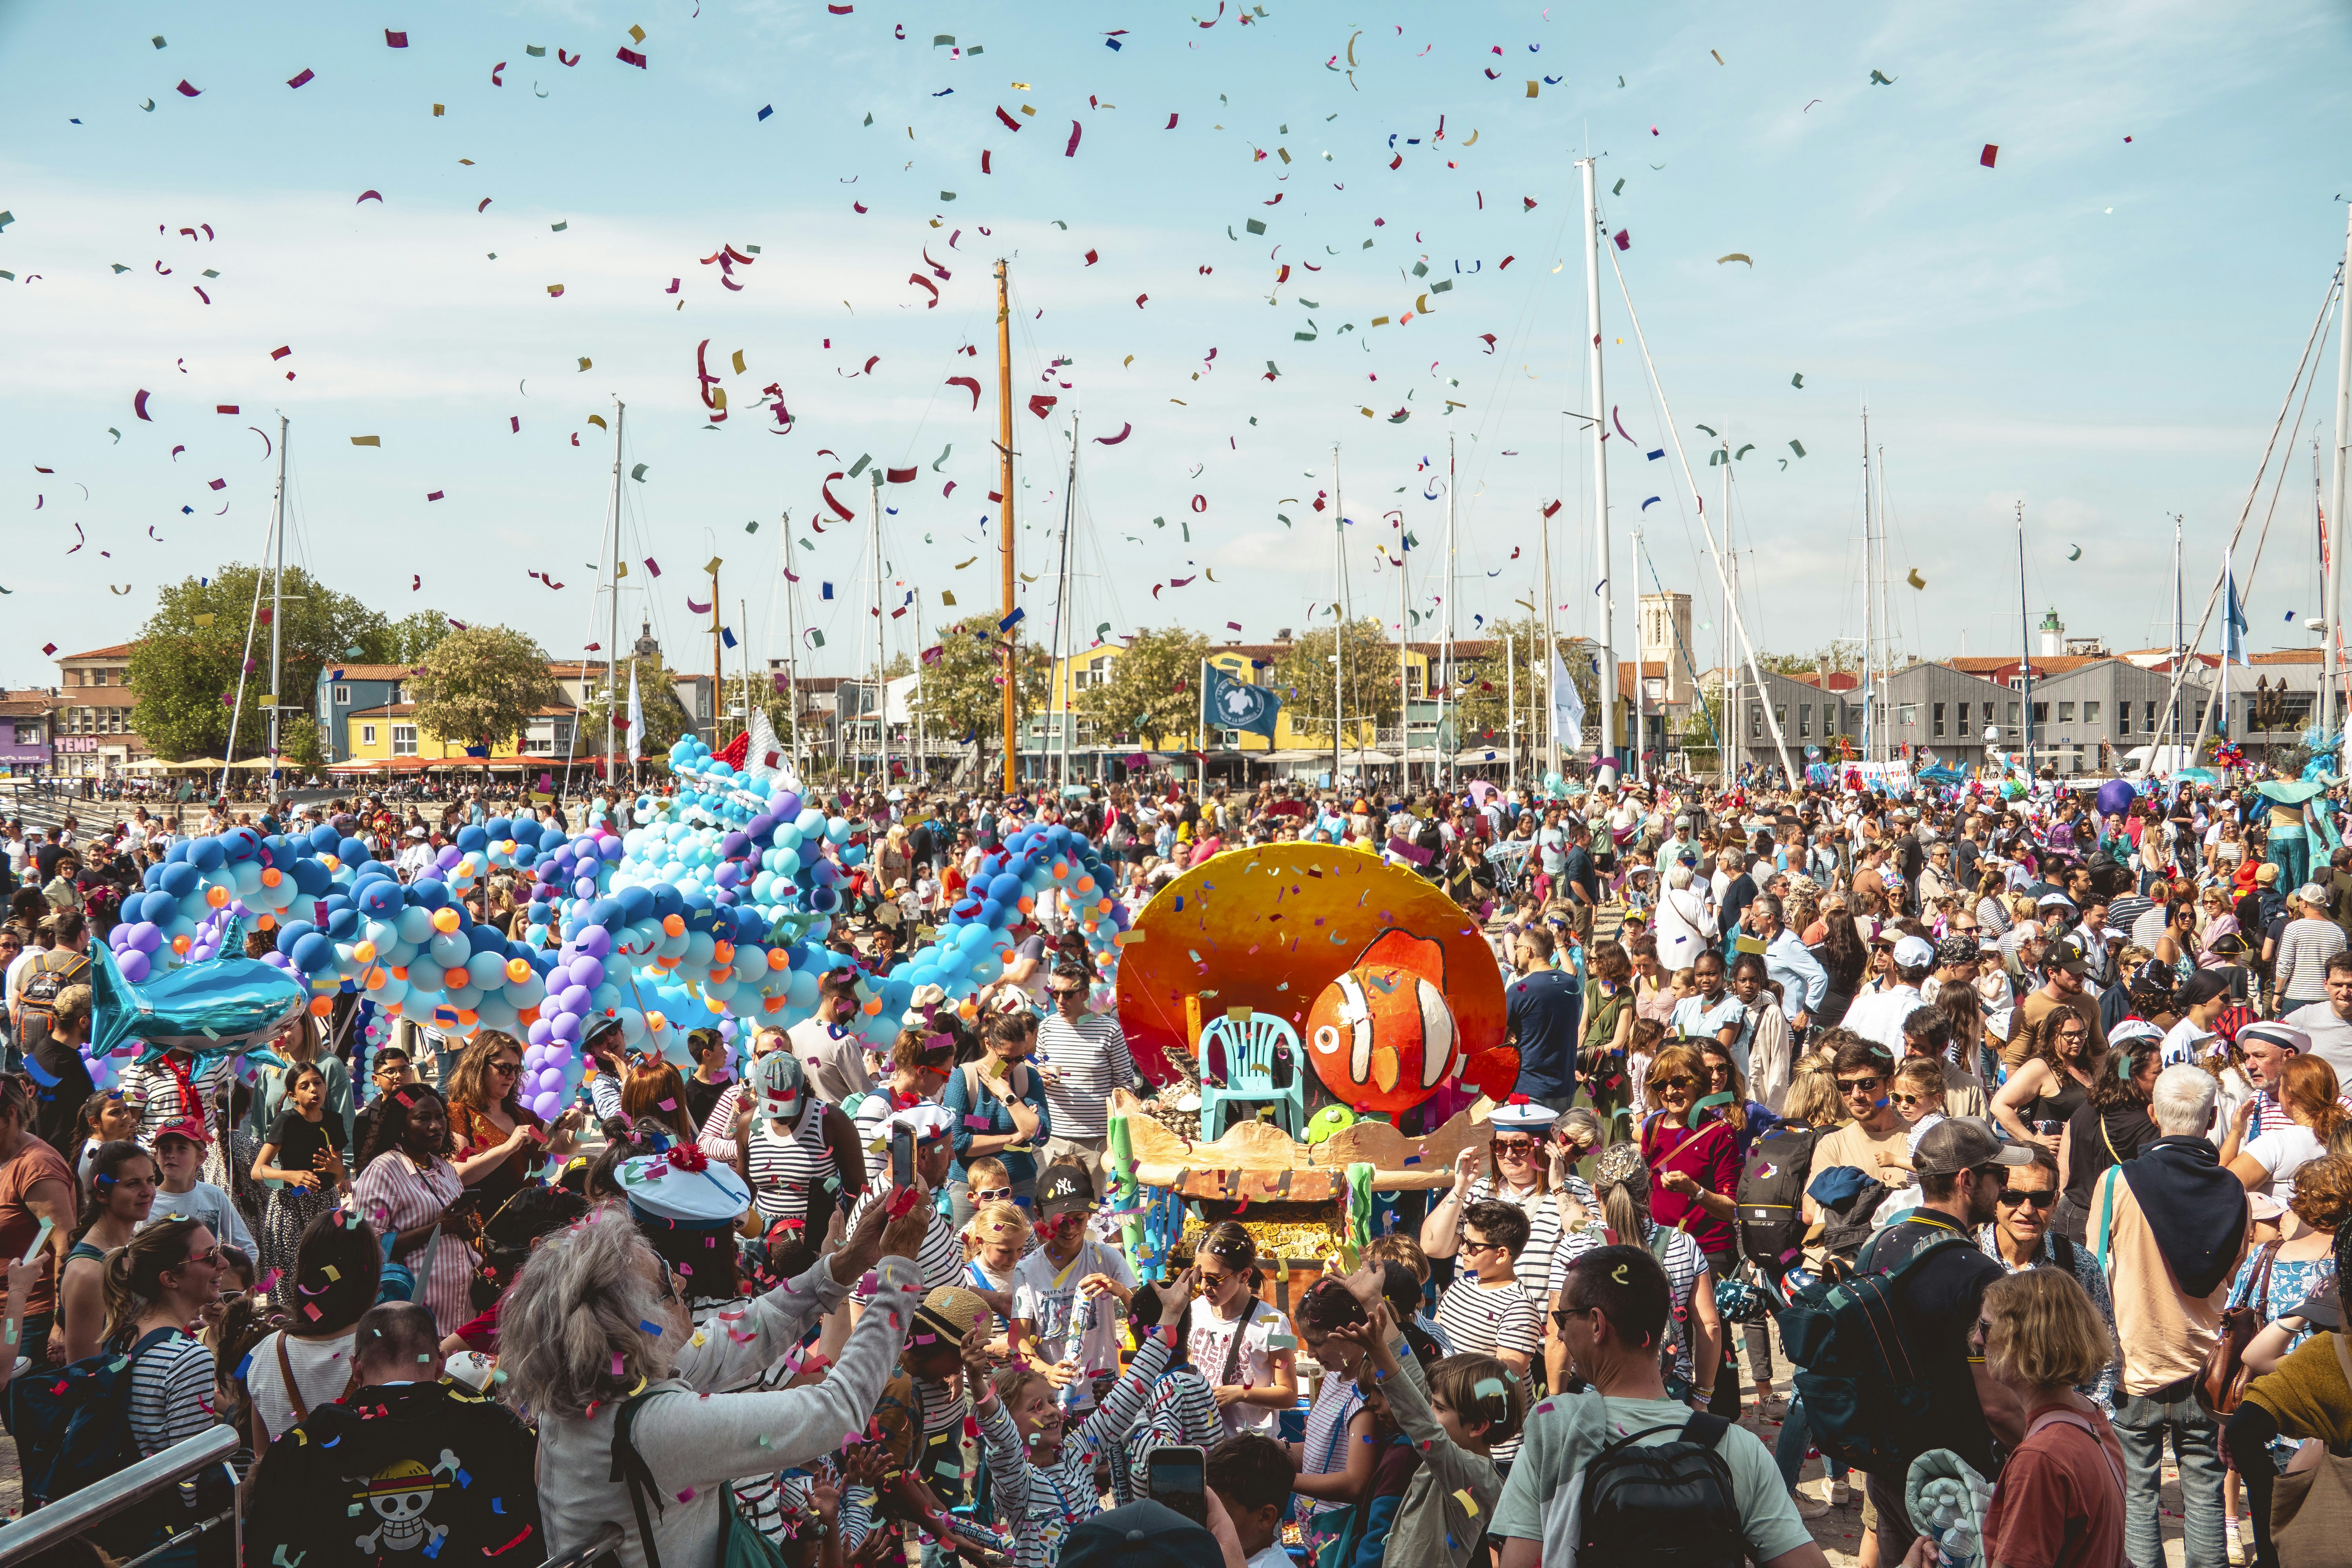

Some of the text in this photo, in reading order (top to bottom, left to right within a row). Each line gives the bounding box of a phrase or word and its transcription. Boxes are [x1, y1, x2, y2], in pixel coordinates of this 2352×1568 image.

[1056, 1177, 1072, 1195] NY
[1112, 1443, 1129, 1506] FETTI CANNON
[955, 1524, 996, 1542] CONFETTI CANNON
